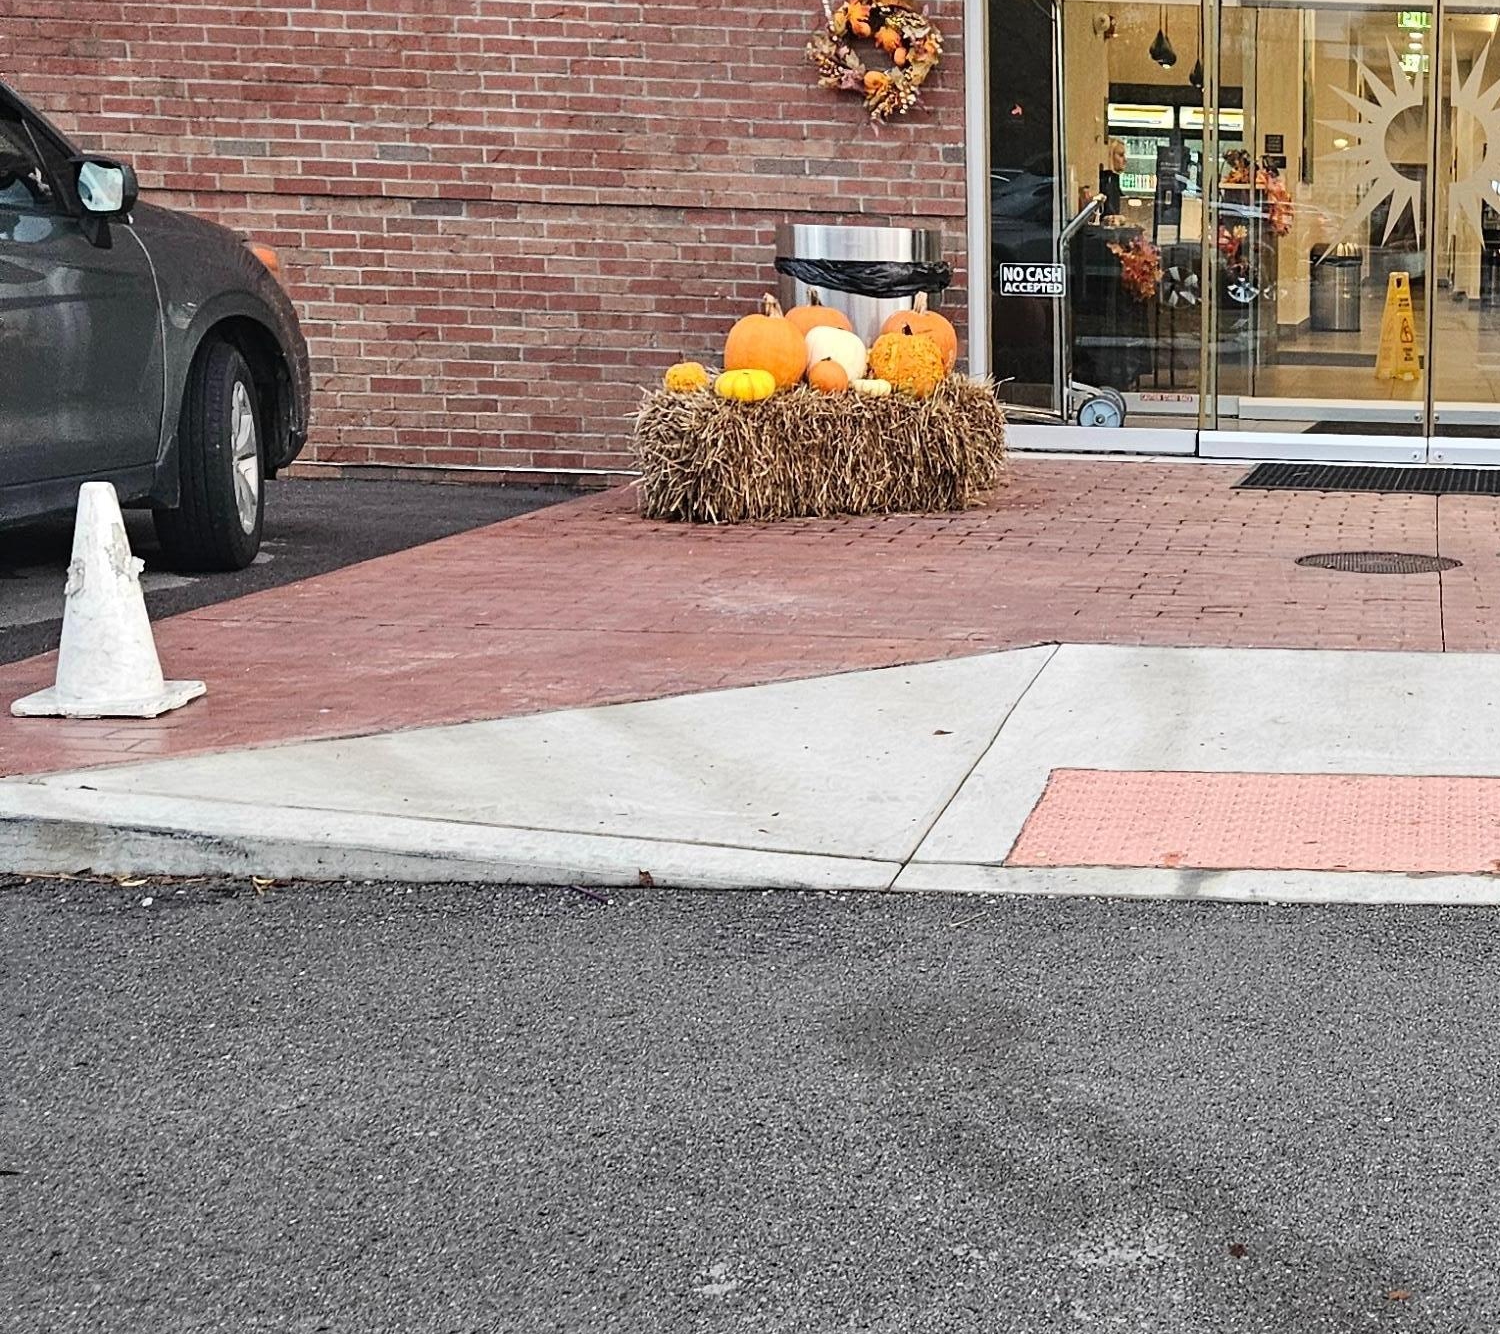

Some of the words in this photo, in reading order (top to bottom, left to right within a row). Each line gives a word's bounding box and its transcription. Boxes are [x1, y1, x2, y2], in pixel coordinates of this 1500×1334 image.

[1003, 266, 1024, 281] NO
[1026, 267, 1062, 282] CASH
[1003, 281, 1063, 294] ACCEPTED
